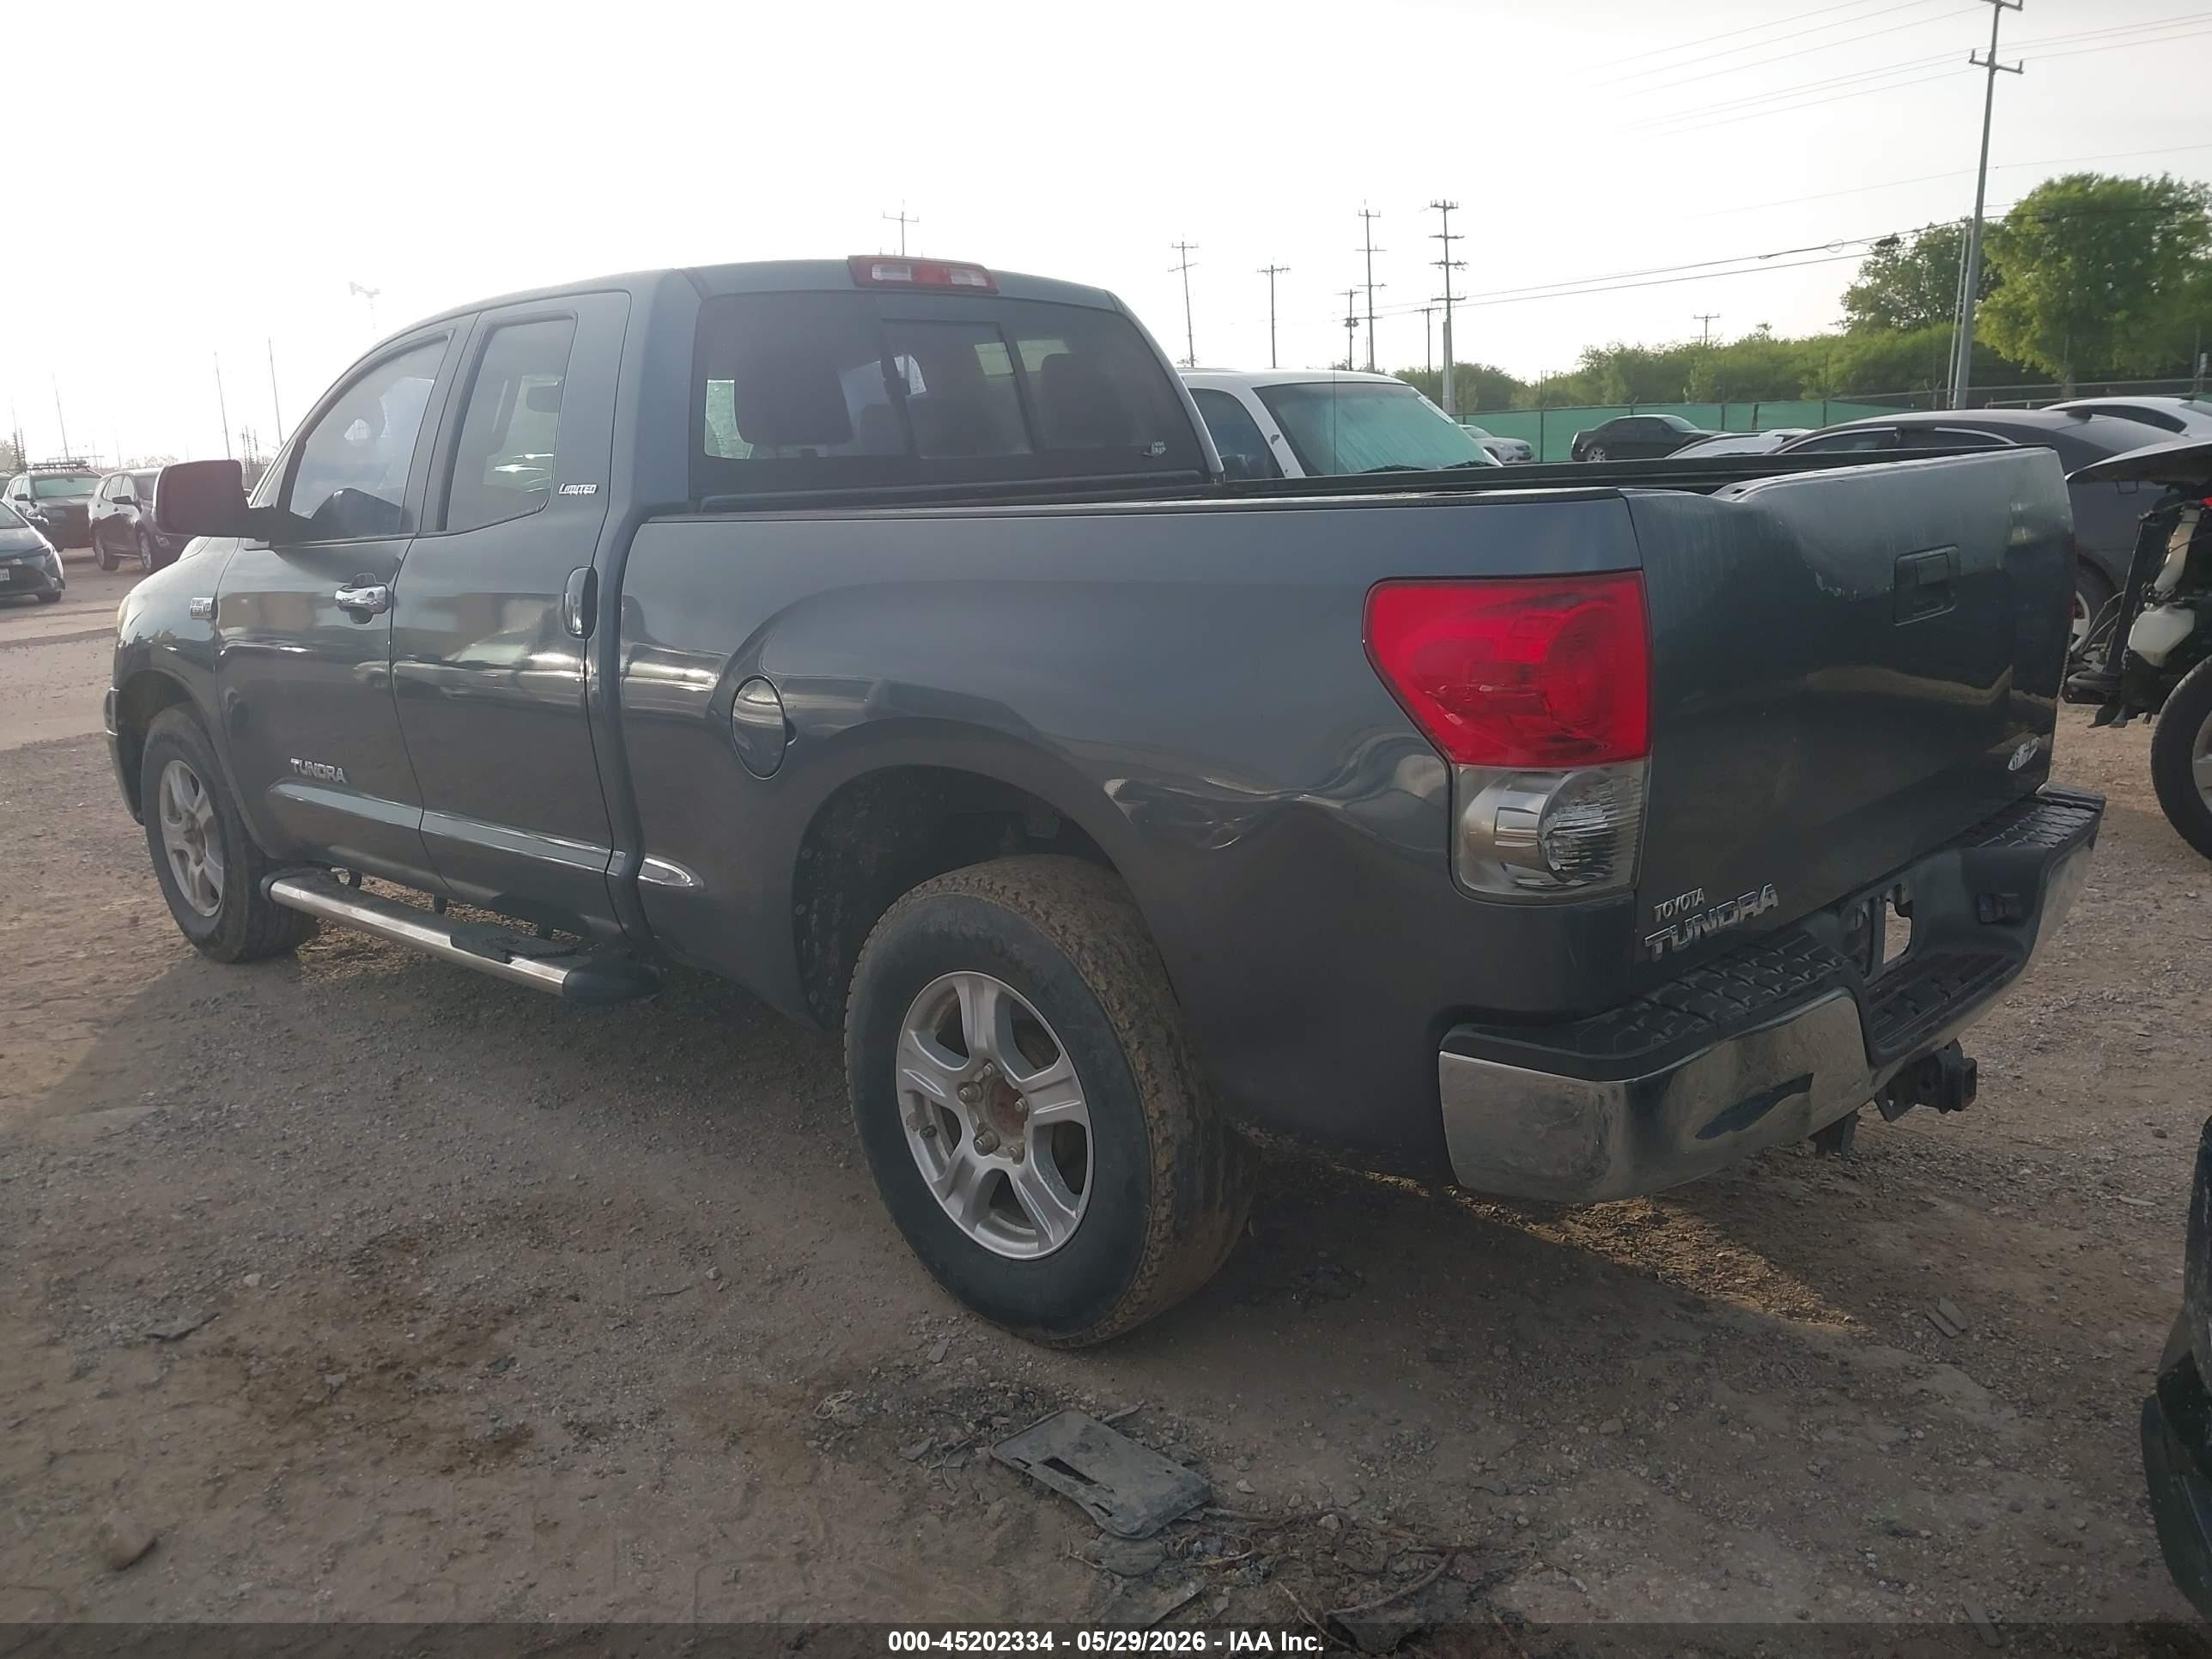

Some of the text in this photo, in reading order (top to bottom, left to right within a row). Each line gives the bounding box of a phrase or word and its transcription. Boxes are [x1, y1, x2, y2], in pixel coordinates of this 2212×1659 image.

[290, 757, 347, 784] TUNDRA
[1654, 887, 1705, 922] TOYOTA
[1644, 883, 1780, 963] TUNDRA
